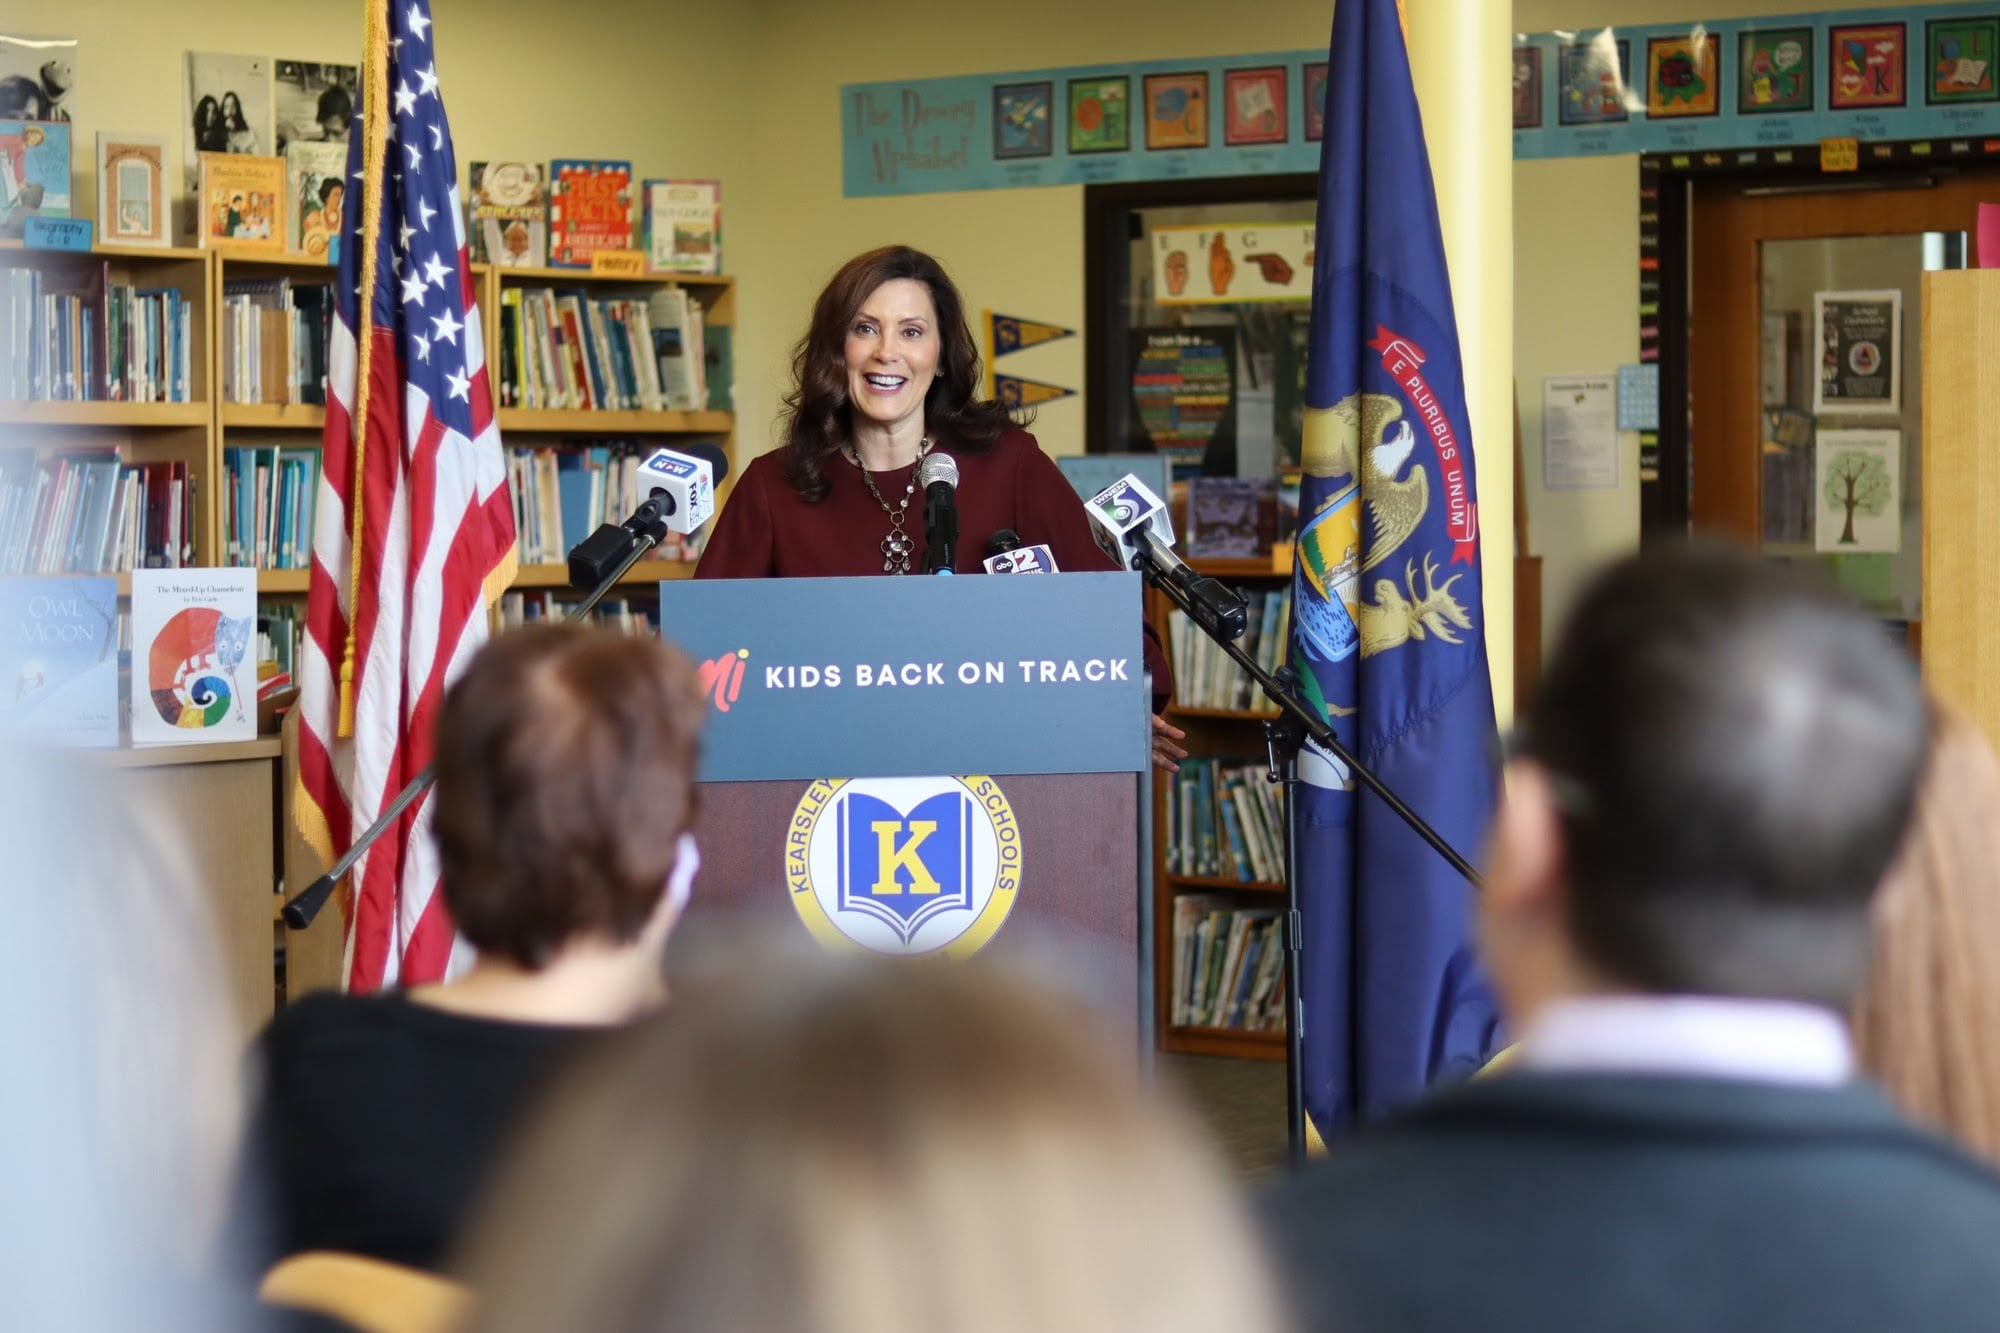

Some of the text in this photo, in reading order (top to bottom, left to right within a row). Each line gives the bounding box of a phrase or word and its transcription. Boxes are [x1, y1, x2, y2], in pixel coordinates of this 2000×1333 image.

[1874, 65, 1890, 96] K
[566, 199, 624, 222] FACTS
[1241, 232, 1257, 248] G
[597, 257, 641, 273] History
[1391, 359, 1465, 526] E PLURIBUS UNUM
[1095, 481, 1128, 505] WNEM
[1113, 488, 1140, 529] 5
[996, 561, 1013, 571] abc
[156, 585, 171, 593] The
[206, 584, 245, 593] Chameleon
[28, 595, 84, 619] OWL
[20, 623, 95, 642] MOON
[766, 664, 841, 688] KIDS
[856, 662, 945, 687] BACK
[958, 661, 1004, 685] ON
[1018, 659, 1129, 683] TRACK
[789, 778, 1018, 894] KEARSLEY SCHOOLS
[871, 820, 941, 895] K
